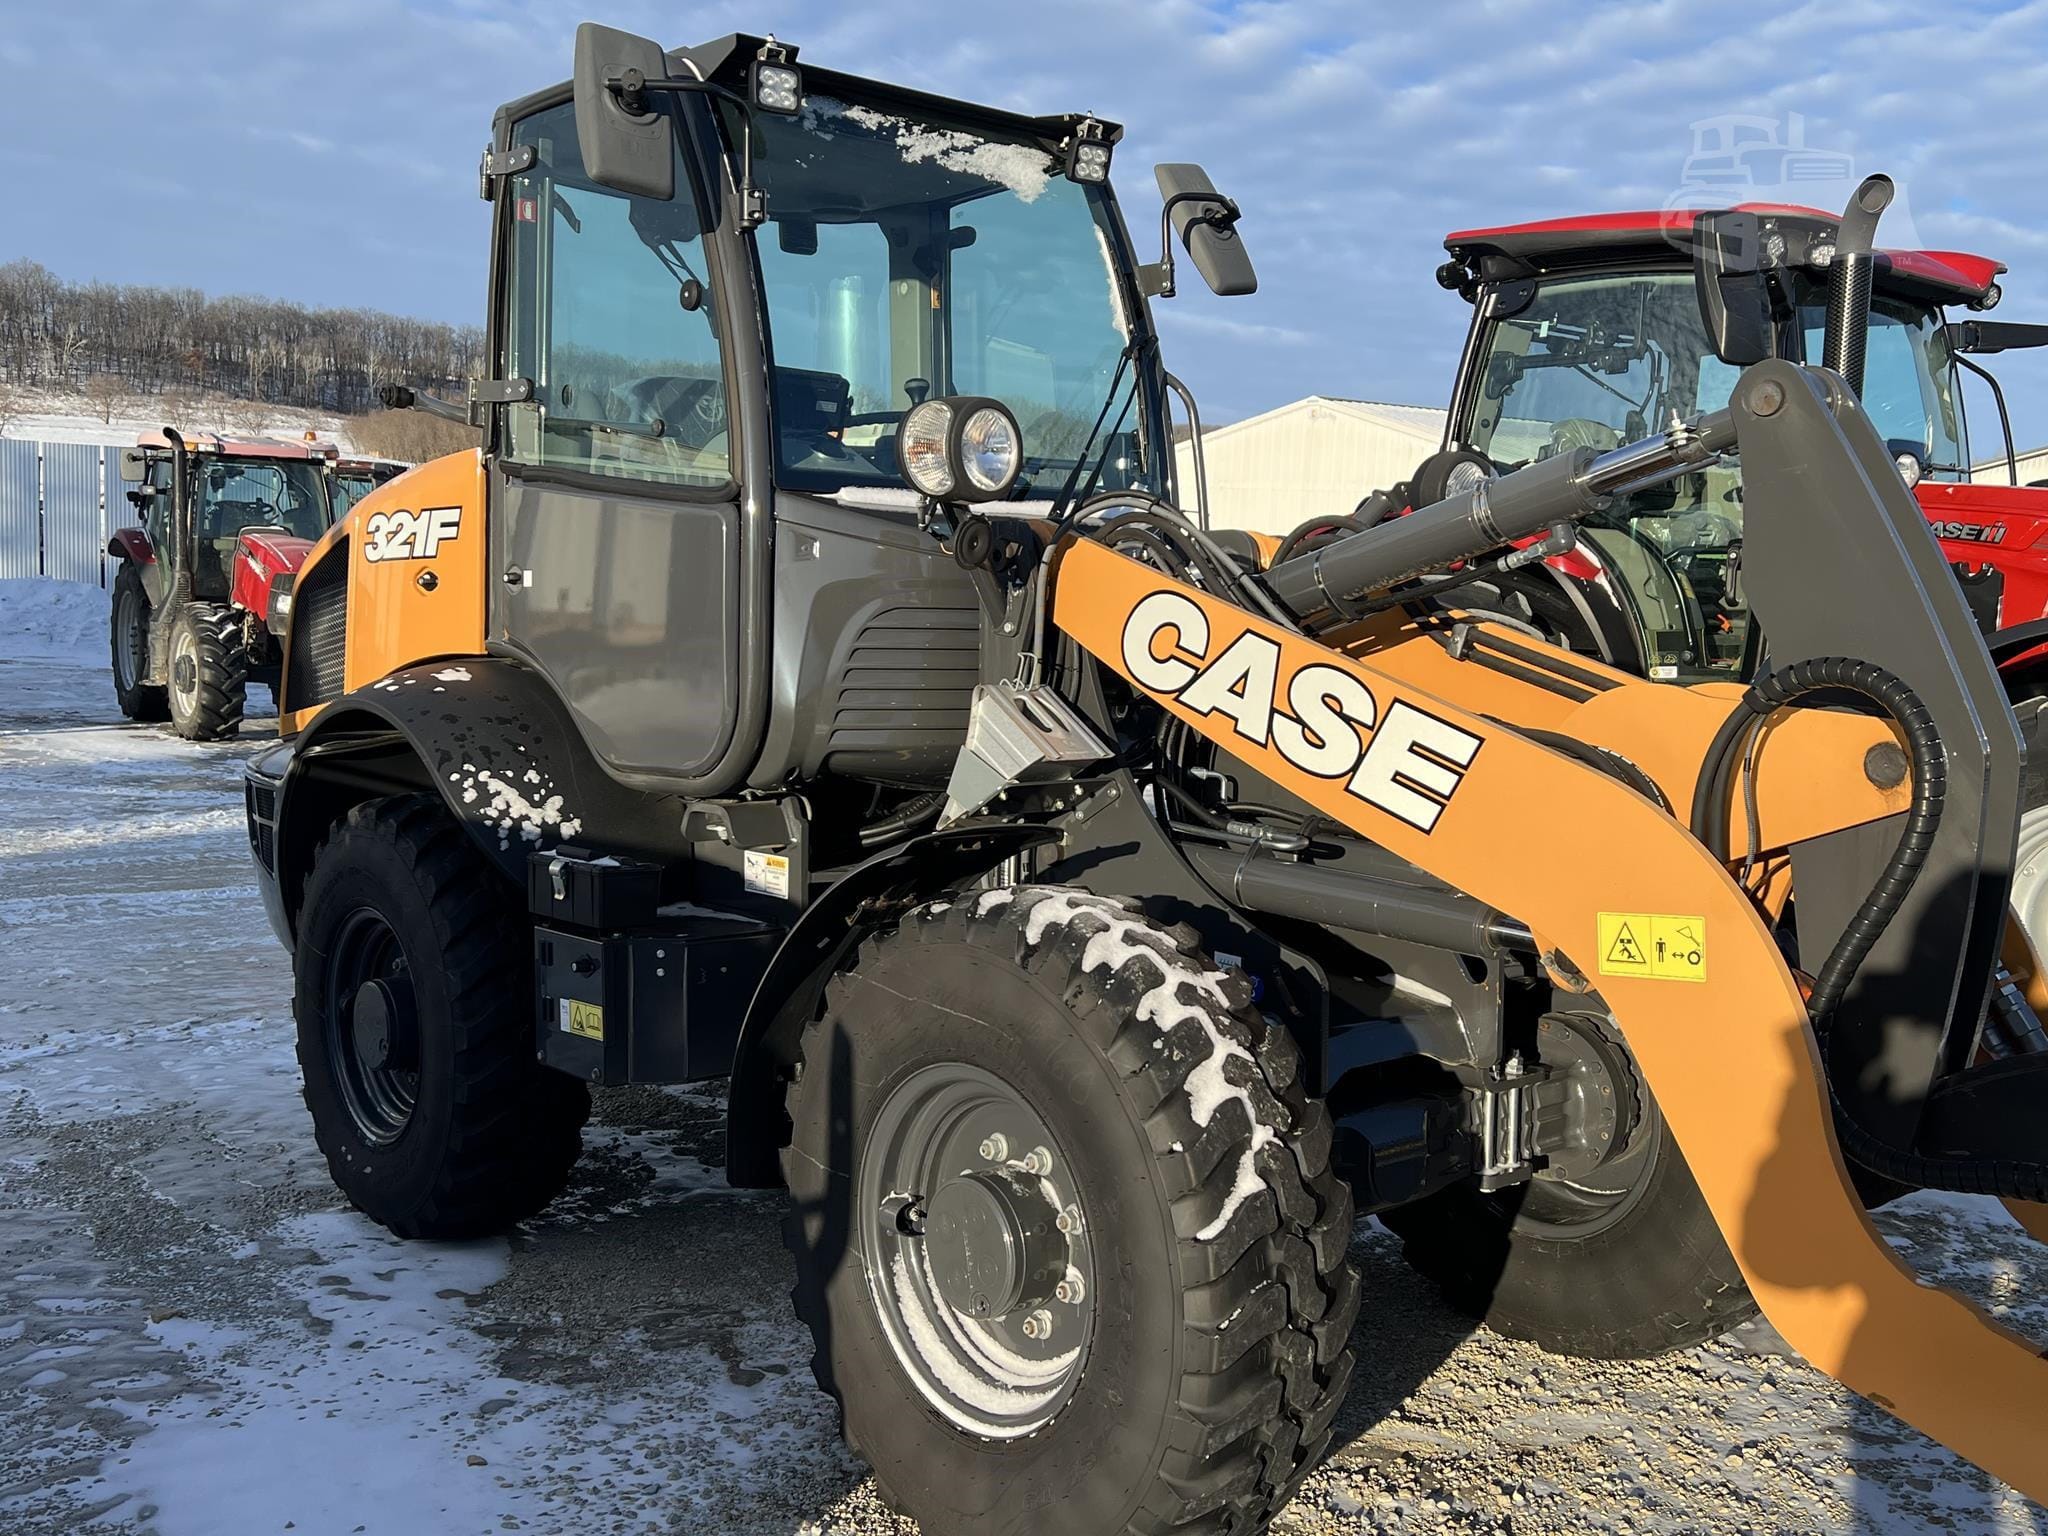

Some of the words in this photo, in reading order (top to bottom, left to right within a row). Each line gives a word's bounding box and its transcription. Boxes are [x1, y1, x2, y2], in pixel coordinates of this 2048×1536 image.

[364, 506, 462, 563] 321F
[1930, 520, 1980, 540] ASE
[1121, 590, 1486, 835] CASE
